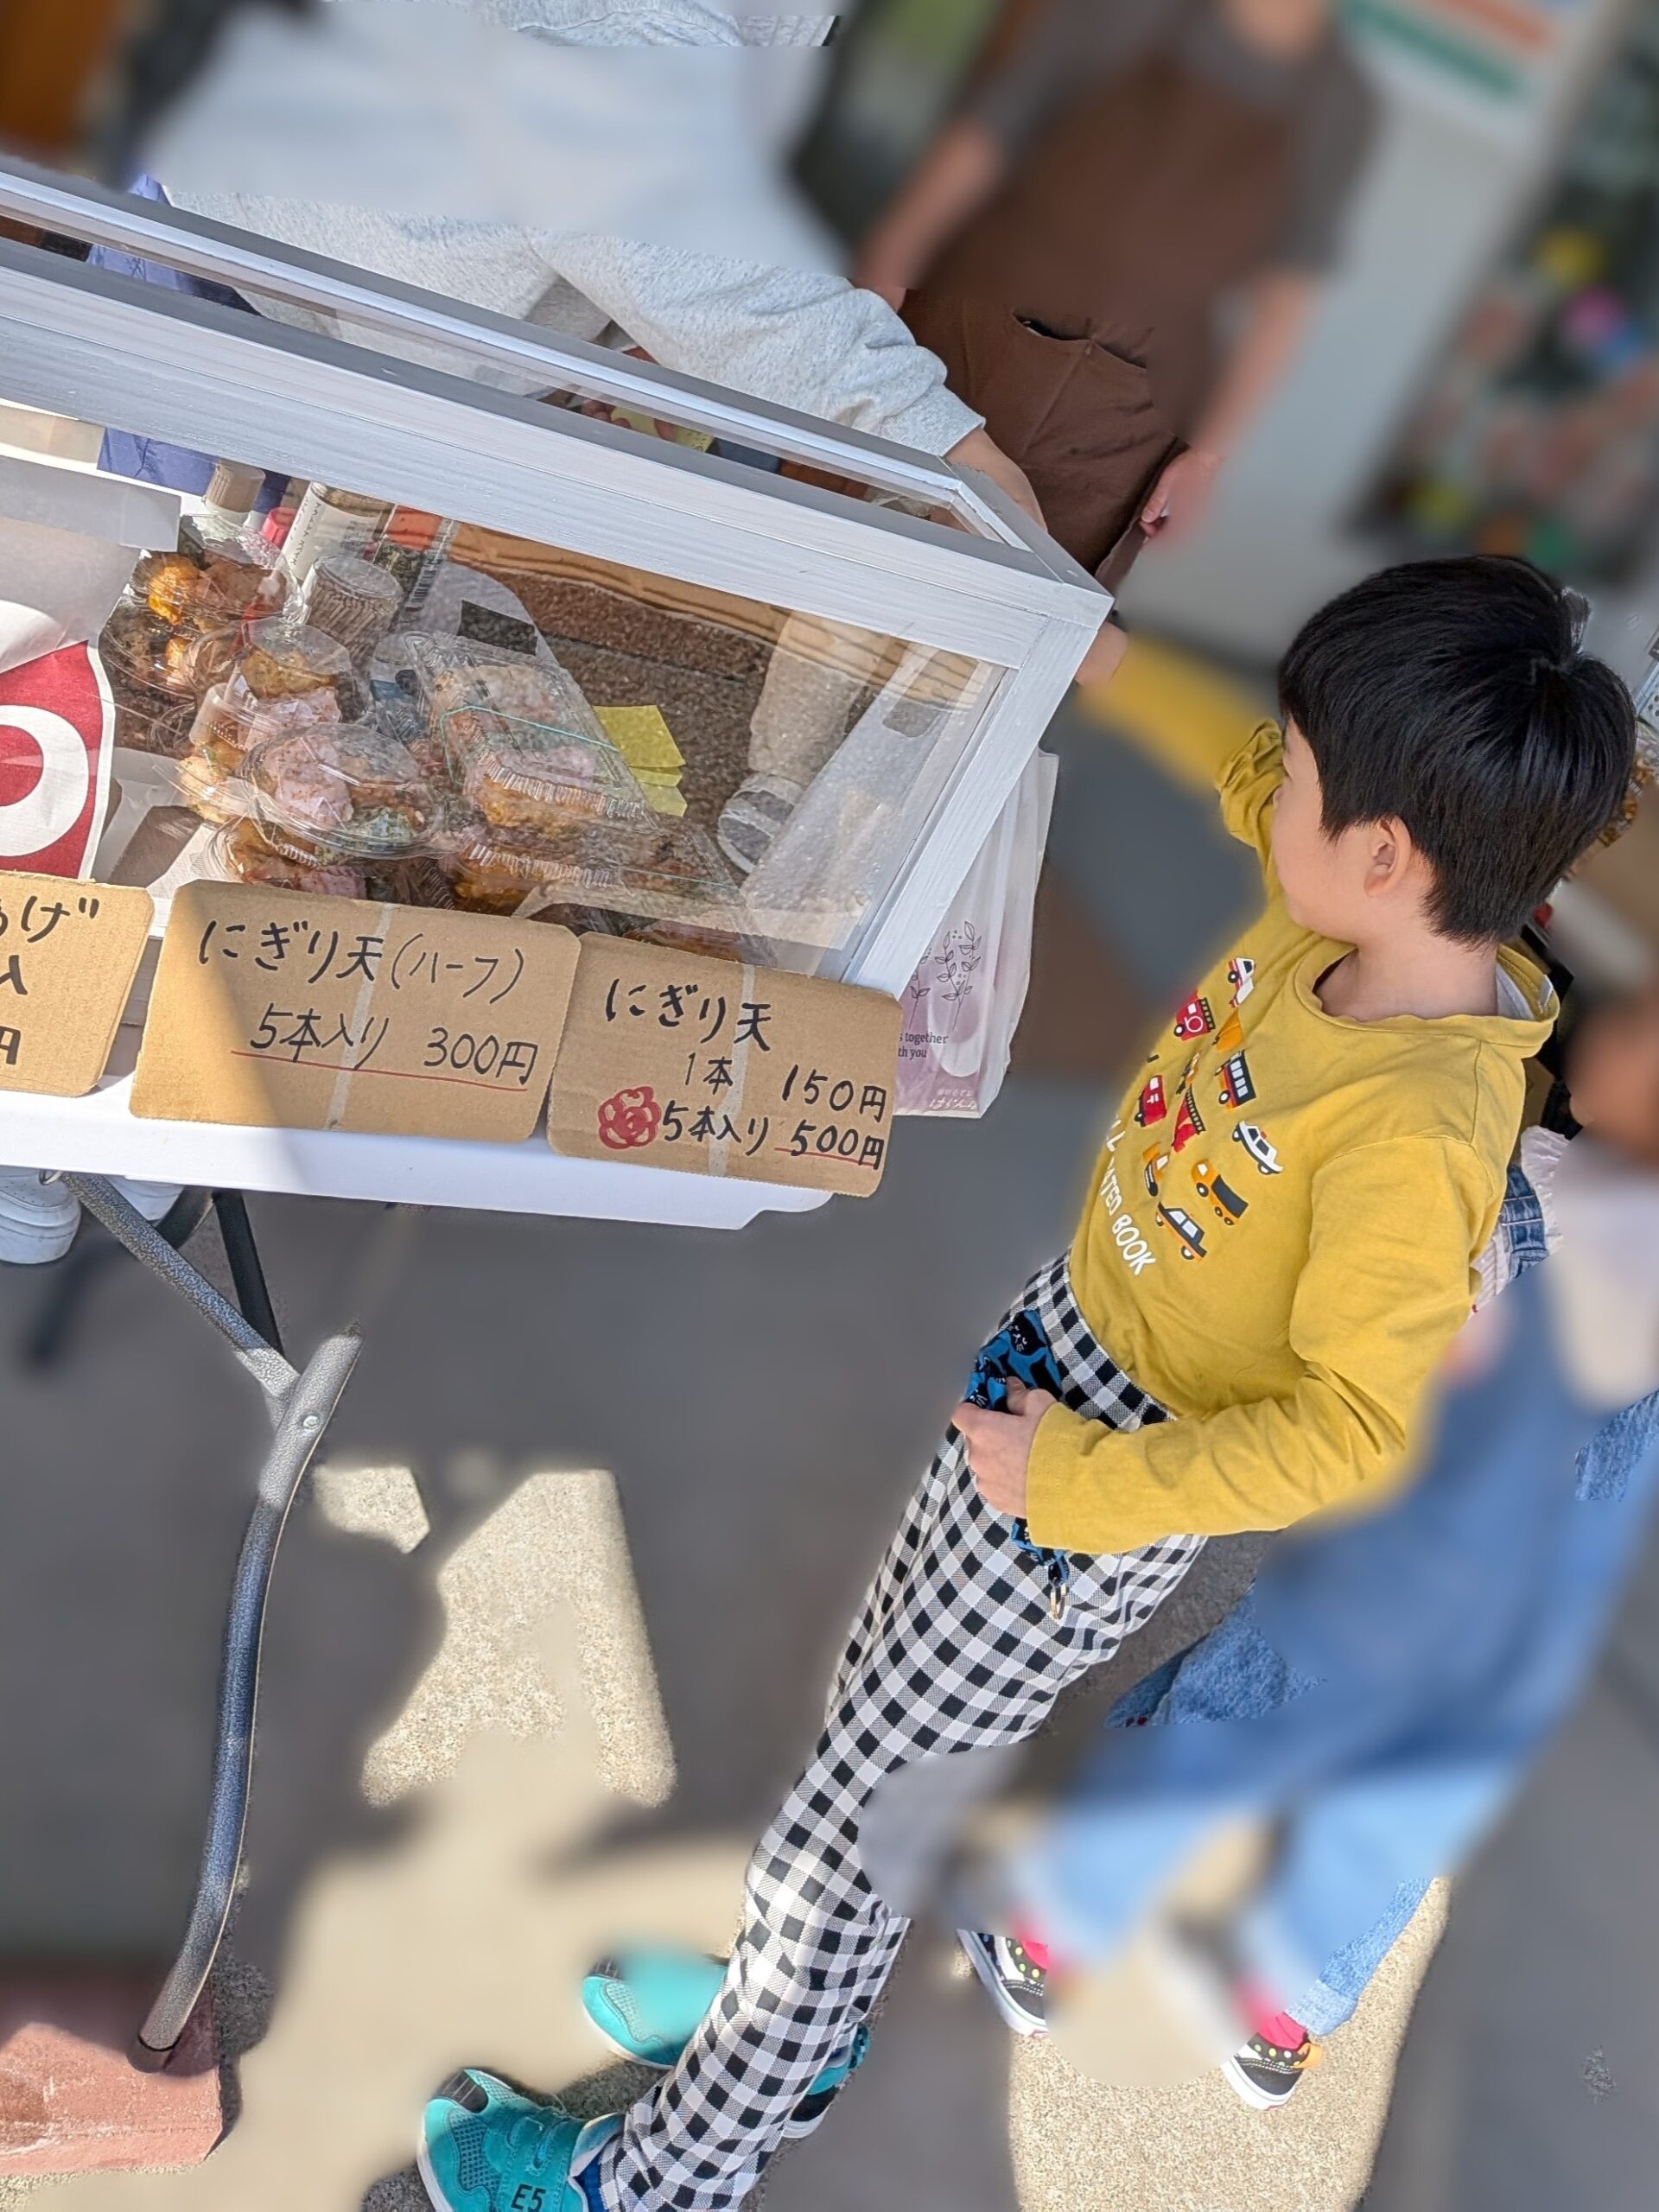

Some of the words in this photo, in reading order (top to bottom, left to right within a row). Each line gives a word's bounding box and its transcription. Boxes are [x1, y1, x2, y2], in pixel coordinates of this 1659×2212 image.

[0, 895, 99, 943] げ
[250, 1003, 390, 1071] 5本入り
[423, 1027, 538, 1084] 300円
[606, 978, 772, 1052] にぎり天
[905, 1031, 949, 1046] together
[910, 1048, 927, 1060] you
[684, 1052, 734, 1095] 1本
[781, 1064, 887, 1124] 150円
[662, 1100, 768, 1157] 5本入り
[791, 1120, 886, 1171] 500円
[1111, 1213, 1157, 1276] BOOK
[511, 2183, 547, 2212] E5
